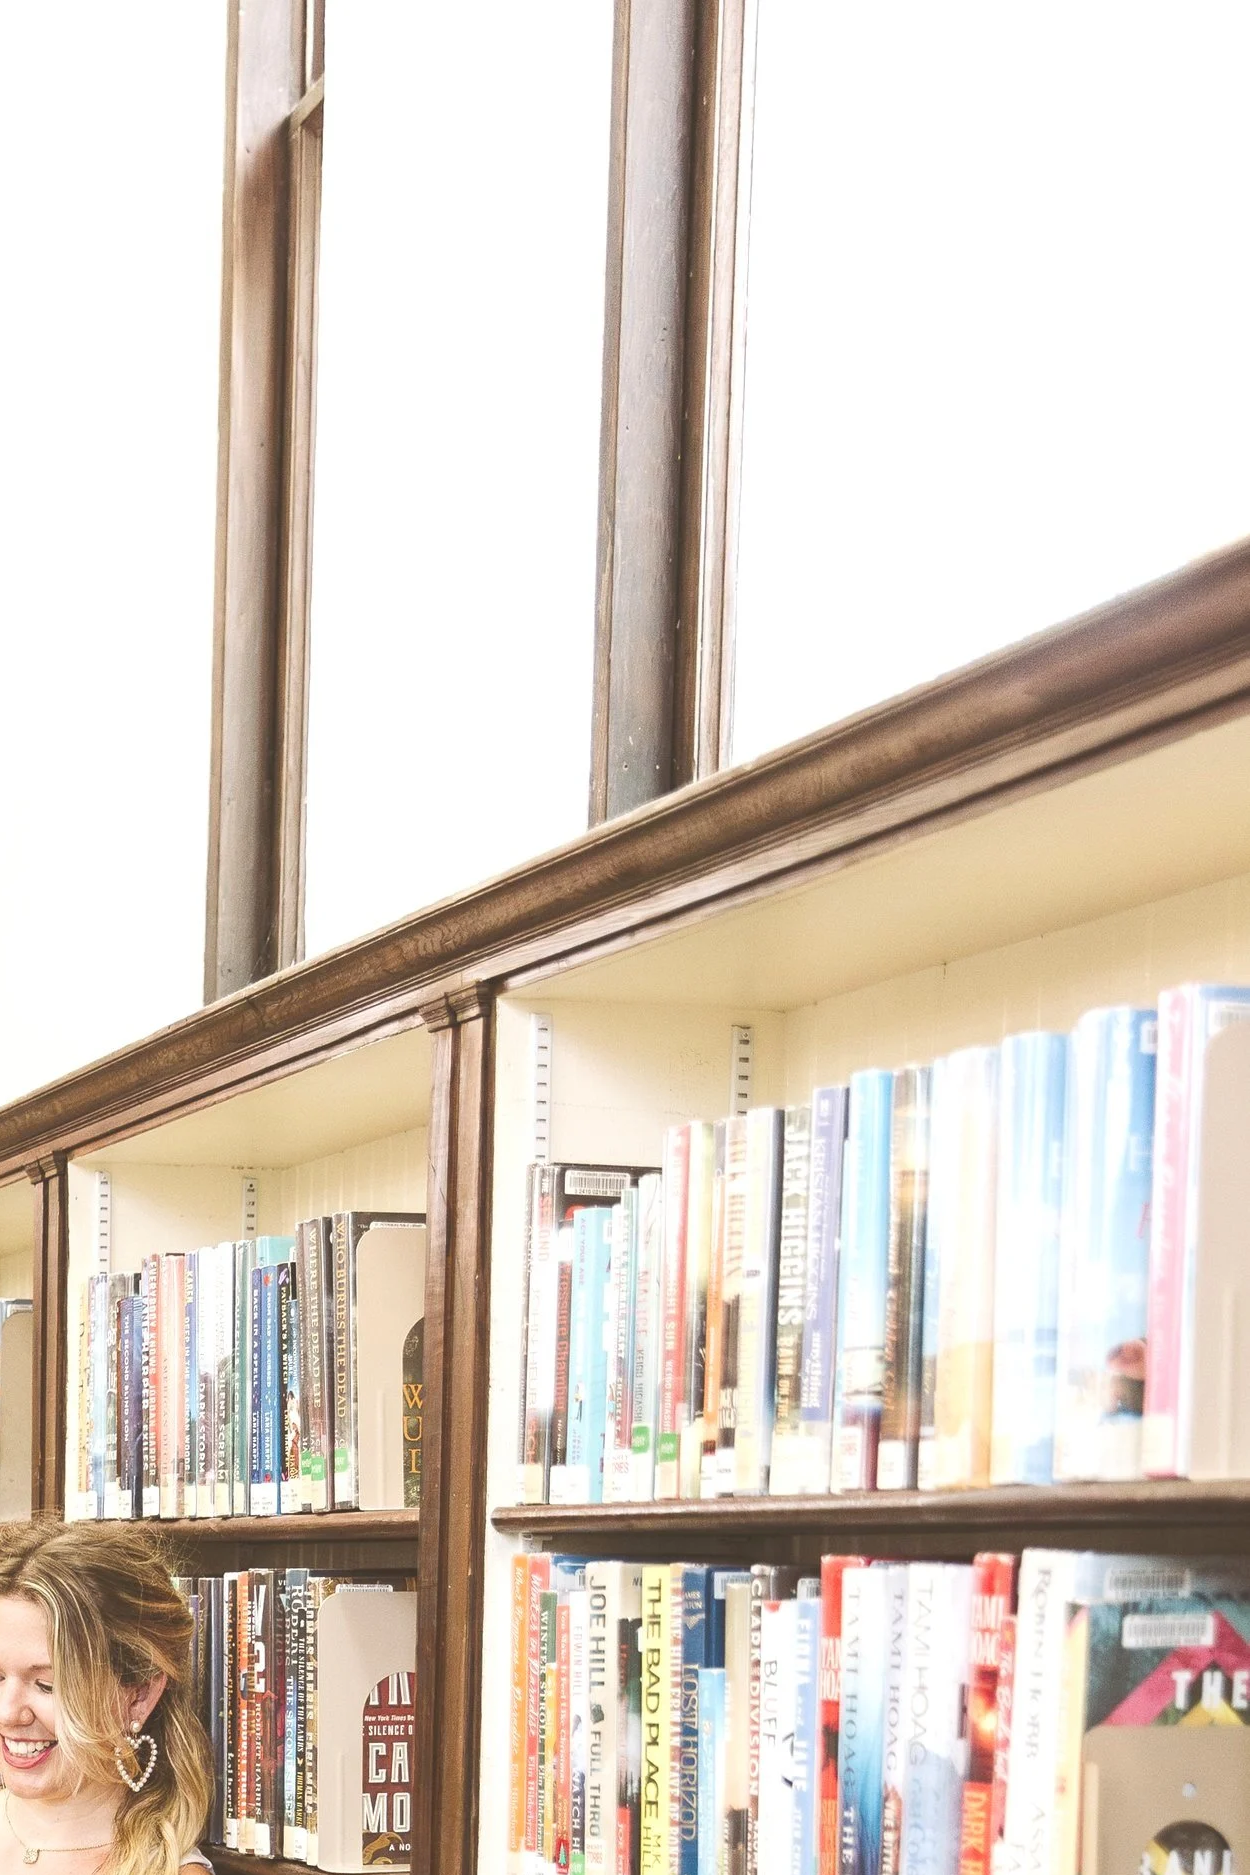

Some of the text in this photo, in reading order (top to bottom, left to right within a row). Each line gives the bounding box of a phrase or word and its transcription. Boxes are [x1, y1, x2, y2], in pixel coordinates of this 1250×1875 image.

[805, 1136, 826, 1320] KRISTAN HIGGINS
[778, 1125, 809, 1419] JACK HIGGINS RAIN ON THE
[309, 1228, 321, 1408] WHERE THE DEAD LIE
[336, 1220, 346, 1417] WHO BURIES THE DEAD
[647, 1579, 662, 1638] THE
[890, 1590, 905, 1670] TAMI
[590, 1576, 606, 1776] JOE HILL FULL
[646, 1648, 661, 1714] BAD
[682, 1664, 698, 1729] LOST
[750, 1580, 761, 1795] CLARK DIVISION
[763, 1660, 778, 1745] BLUFF
[909, 1580, 933, 1765] TAMI HOAG
[368, 1725, 405, 1737] SILENCE
[368, 1741, 410, 1784] CA
[842, 1588, 860, 1864] TAMI HOAG THE
[886, 1684, 902, 1771] HOAG
[362, 1792, 411, 1833] MO
[644, 1722, 659, 1818] PLACE
[642, 1826, 651, 1875] HILL
[884, 1800, 896, 1827] THE
[962, 1791, 987, 1852] DARK
